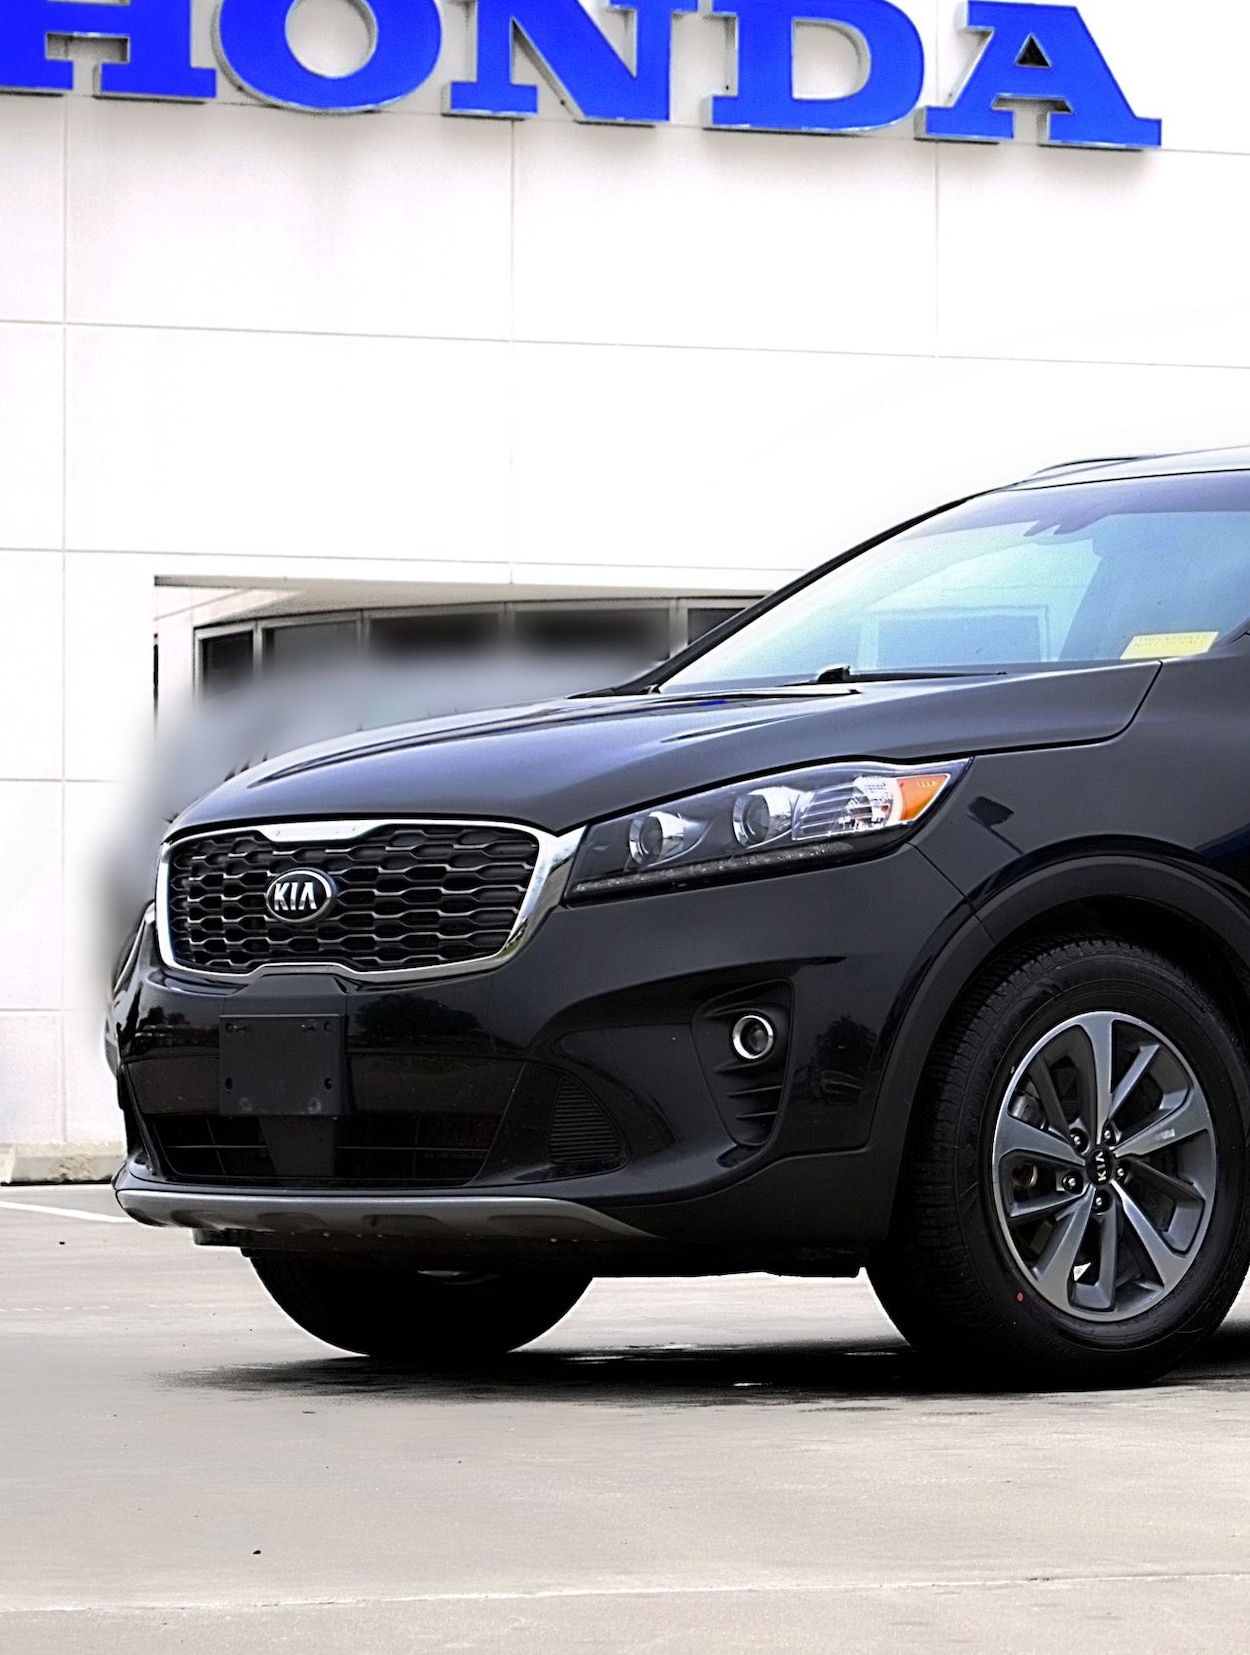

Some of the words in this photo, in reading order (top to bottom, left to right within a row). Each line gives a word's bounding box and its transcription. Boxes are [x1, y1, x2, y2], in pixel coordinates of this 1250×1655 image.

[0, 0, 1163, 147] HONDA
[274, 882, 317, 910] KIA
[1095, 1151, 1107, 1182] KIA
